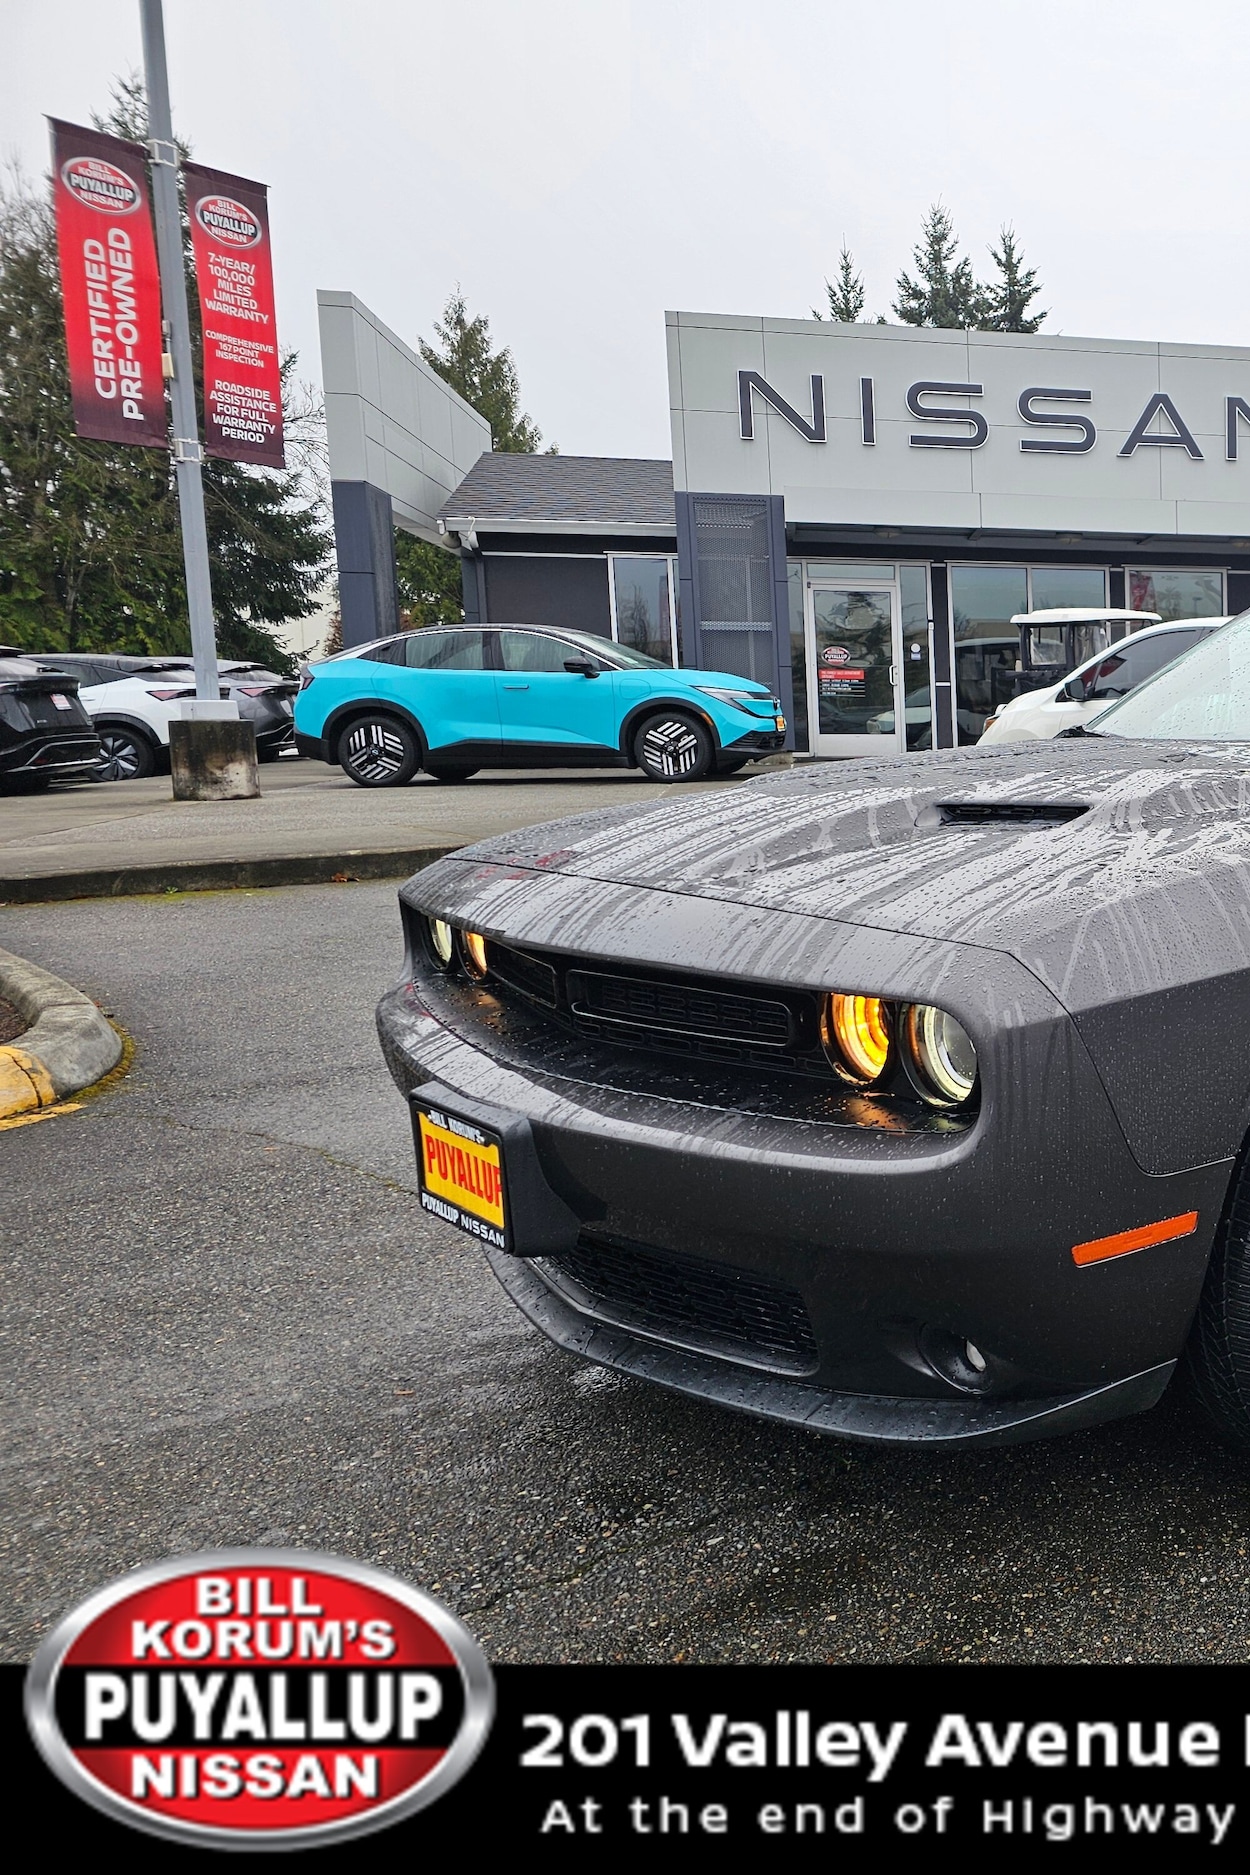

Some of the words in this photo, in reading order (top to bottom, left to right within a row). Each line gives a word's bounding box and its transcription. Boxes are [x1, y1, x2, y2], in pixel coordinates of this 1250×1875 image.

[88, 161, 111, 175] BILL
[70, 173, 134, 201] PUYALLUP
[80, 190, 124, 209] NISSAN
[217, 200, 237, 211] BILL
[203, 210, 256, 236] PUYALLUP
[211, 226, 248, 243] NISSAN
[208, 252, 255, 275] 7-YEAR/
[208, 264, 255, 287] 100,000
[217, 278, 252, 297] MILES
[213, 288, 258, 310] LIMITED
[83, 238, 117, 399] CERTIFIED
[204, 298, 269, 324] WARRANTY
[107, 227, 145, 421] PRE-OWNED
[205, 329, 274, 353] COMPREHENSIVE
[219, 342, 231, 352] 167
[233, 346, 260, 358] POINT
[215, 349, 265, 368] INSPECTION
[215, 379, 270, 401] ROADSIDE
[209, 390, 277, 413] ASSISTANCE
[217, 402, 239, 417] FOR
[240, 407, 269, 423] FULL
[212, 413, 276, 434] WARRANTY
[222, 426, 265, 443] PERIOD
[421, 1192, 460, 1225] PUYALLUP
[460, 1213, 505, 1249] NISSAN
